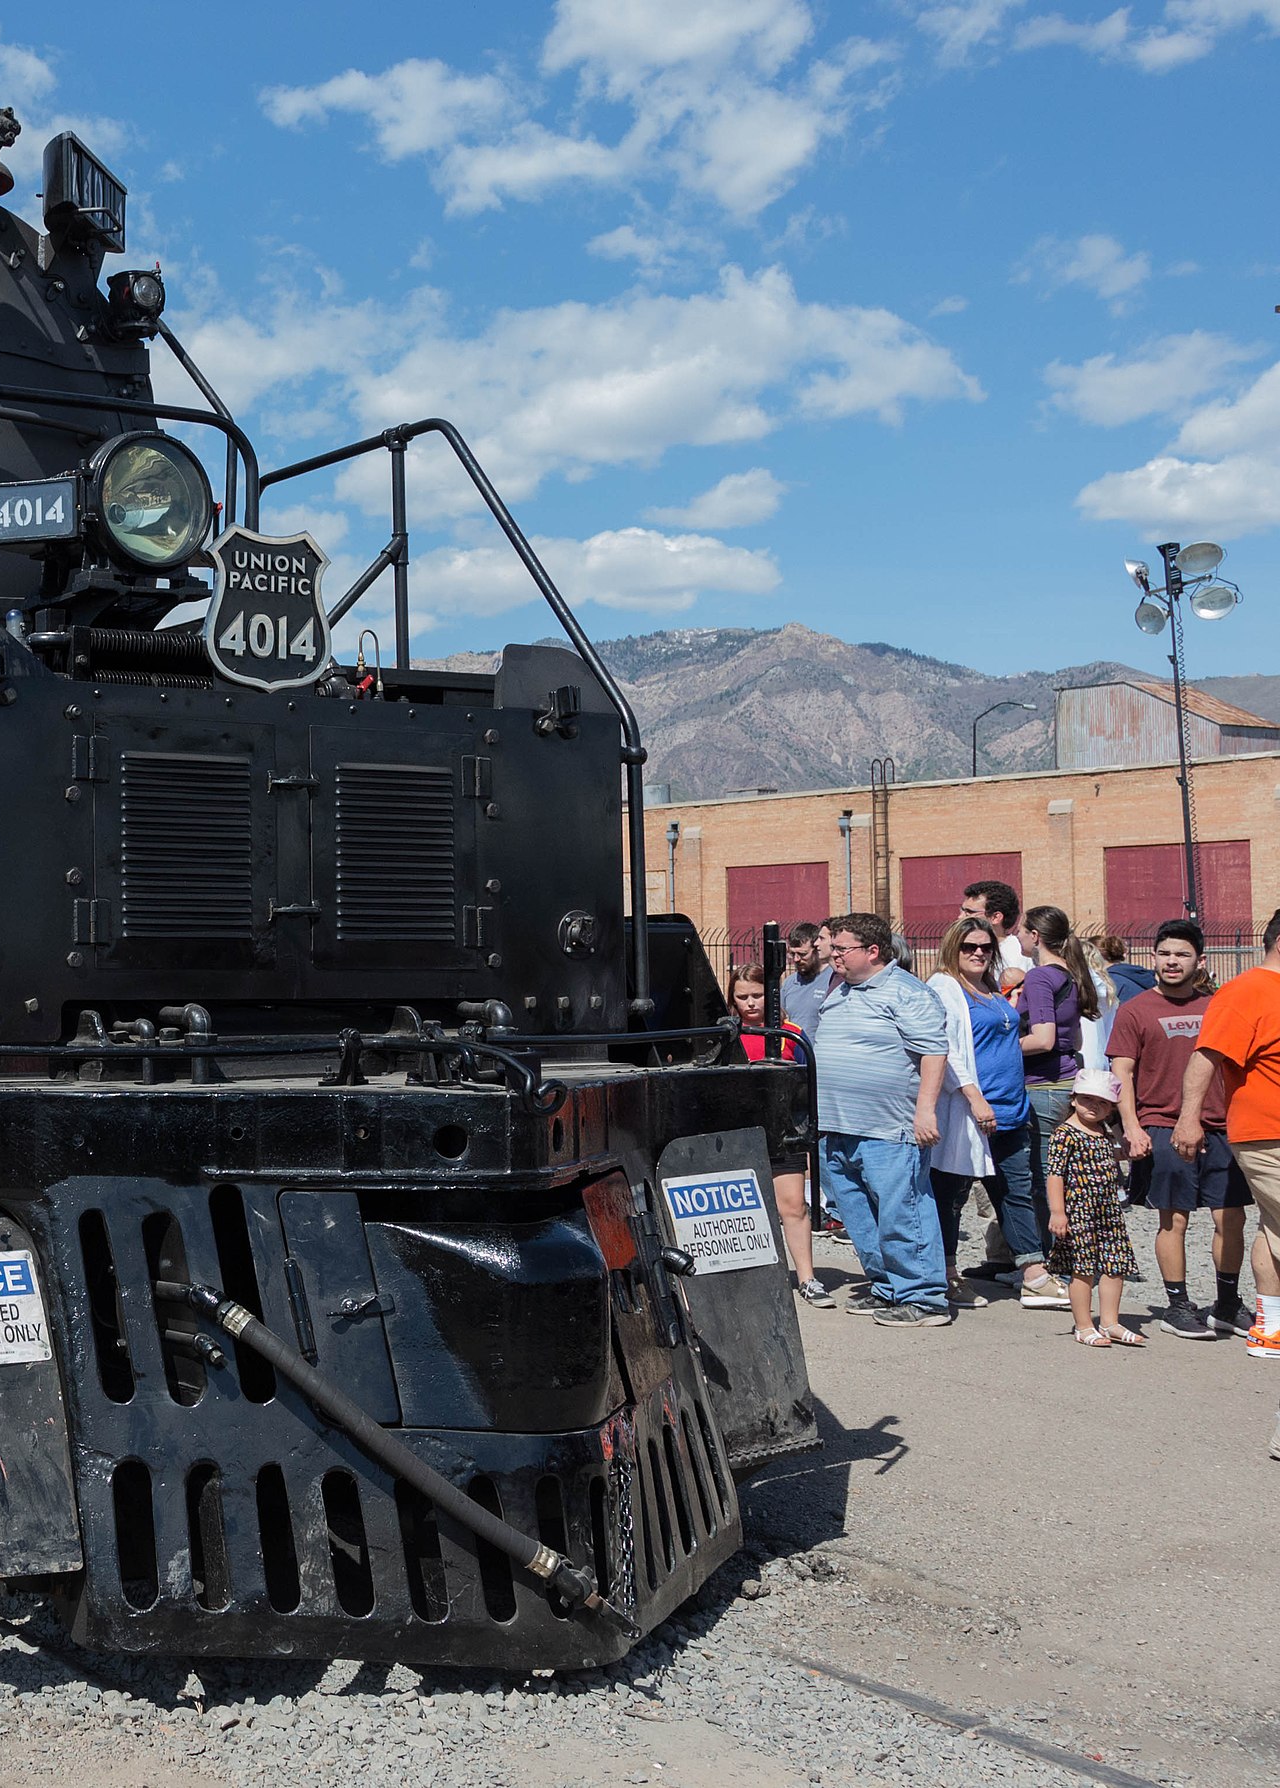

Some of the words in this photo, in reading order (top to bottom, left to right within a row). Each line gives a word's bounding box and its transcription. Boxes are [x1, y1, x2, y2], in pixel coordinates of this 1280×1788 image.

[235, 551, 306, 574] UNION
[229, 571, 311, 595] PACIFIC
[219, 610, 317, 662] 4014
[673, 1182, 757, 1215] NOTICE
[693, 1216, 756, 1239] AUTHORIZED
[683, 1236, 746, 1258] PERSONNEL
[747, 1232, 772, 1251] ONLY
[4, 1323, 42, 1344] ONLY
